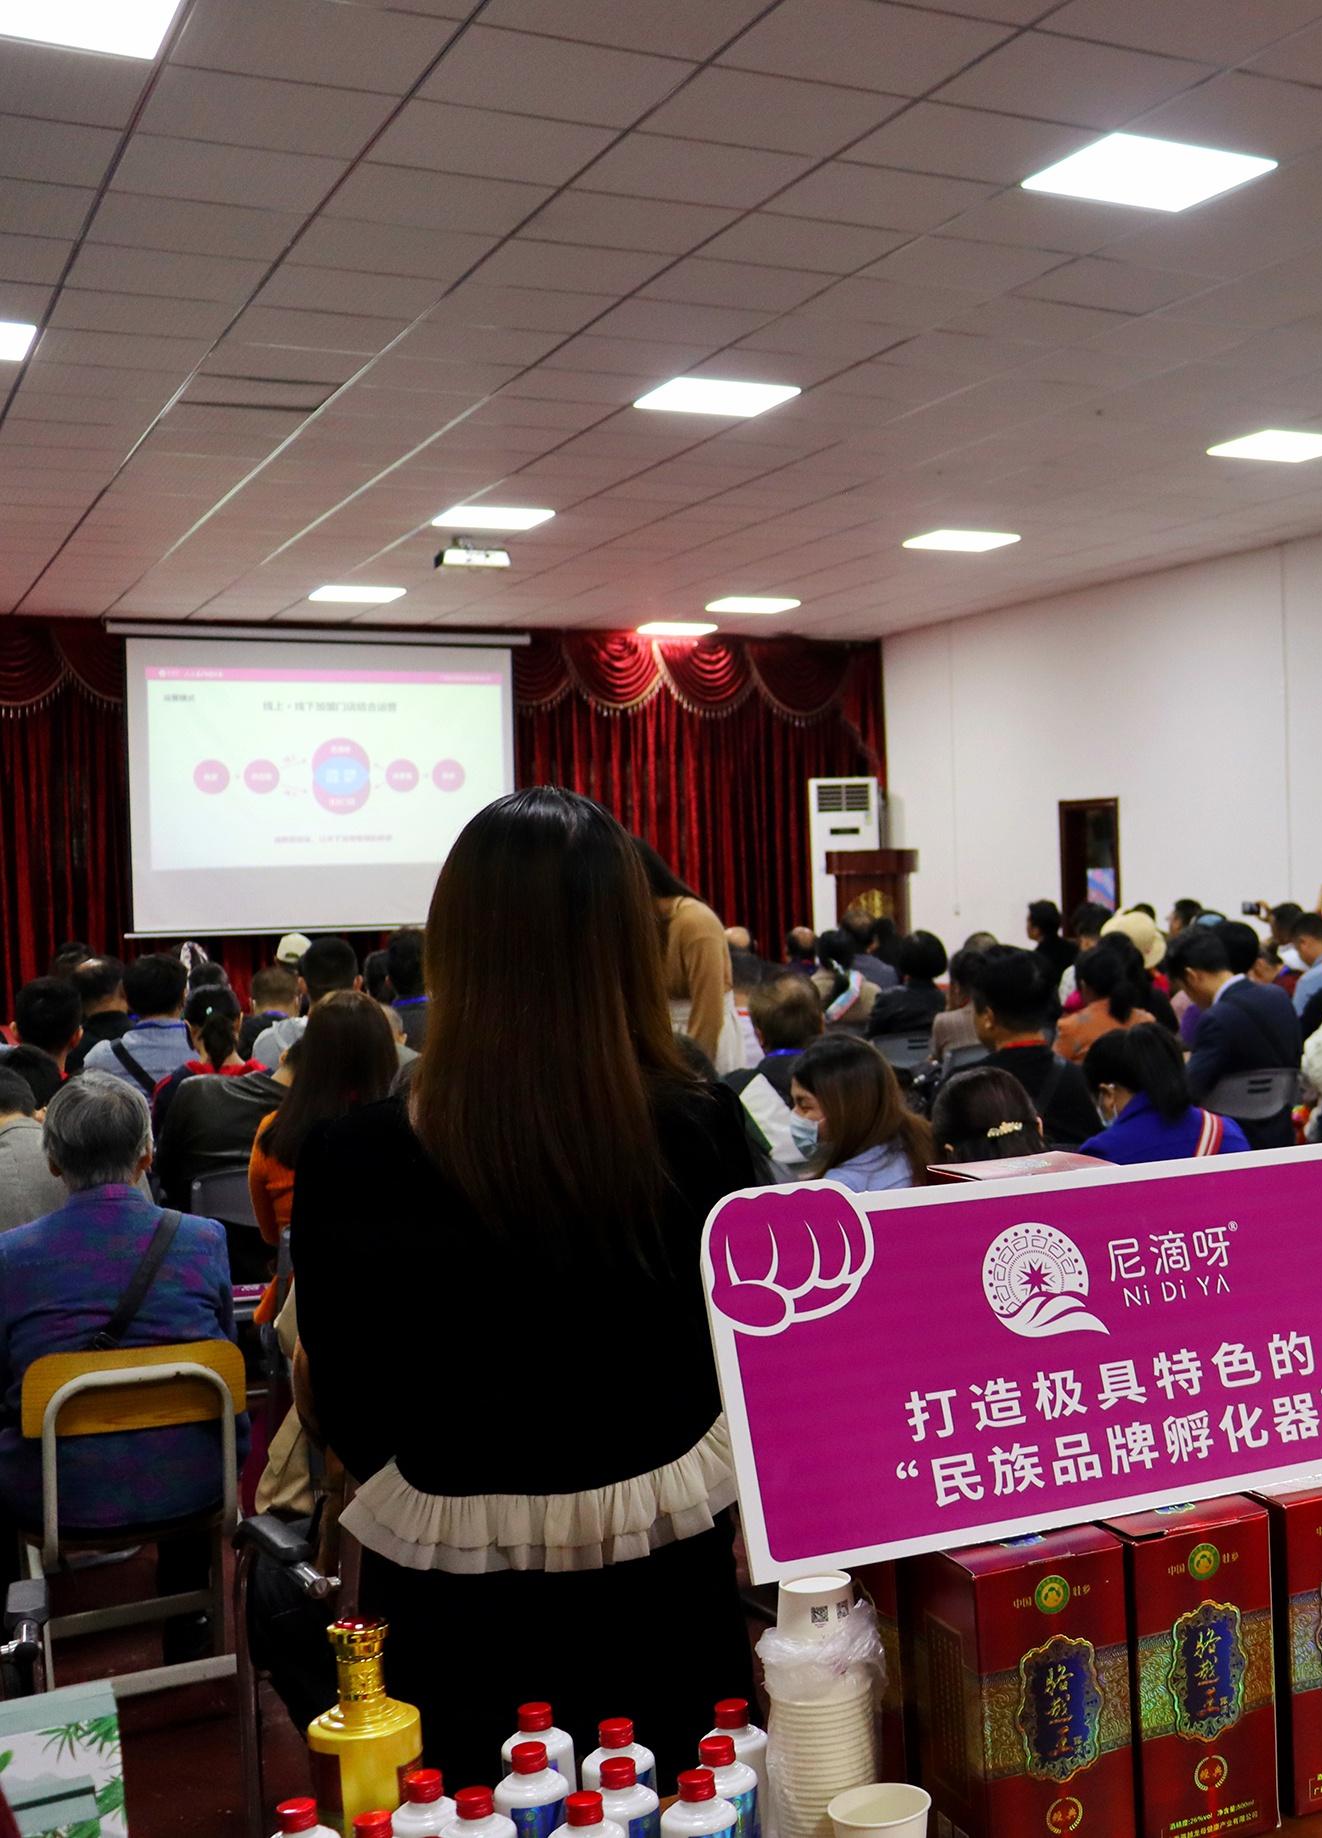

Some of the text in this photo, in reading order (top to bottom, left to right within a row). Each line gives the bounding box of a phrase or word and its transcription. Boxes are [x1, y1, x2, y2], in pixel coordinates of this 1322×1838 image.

[1108, 1227, 1230, 1282] 尼滴呀
[1123, 1284, 1150, 1307] Ni
[1161, 1280, 1186, 1302] Di
[905, 1331, 1315, 1442] 打造极具特色的
